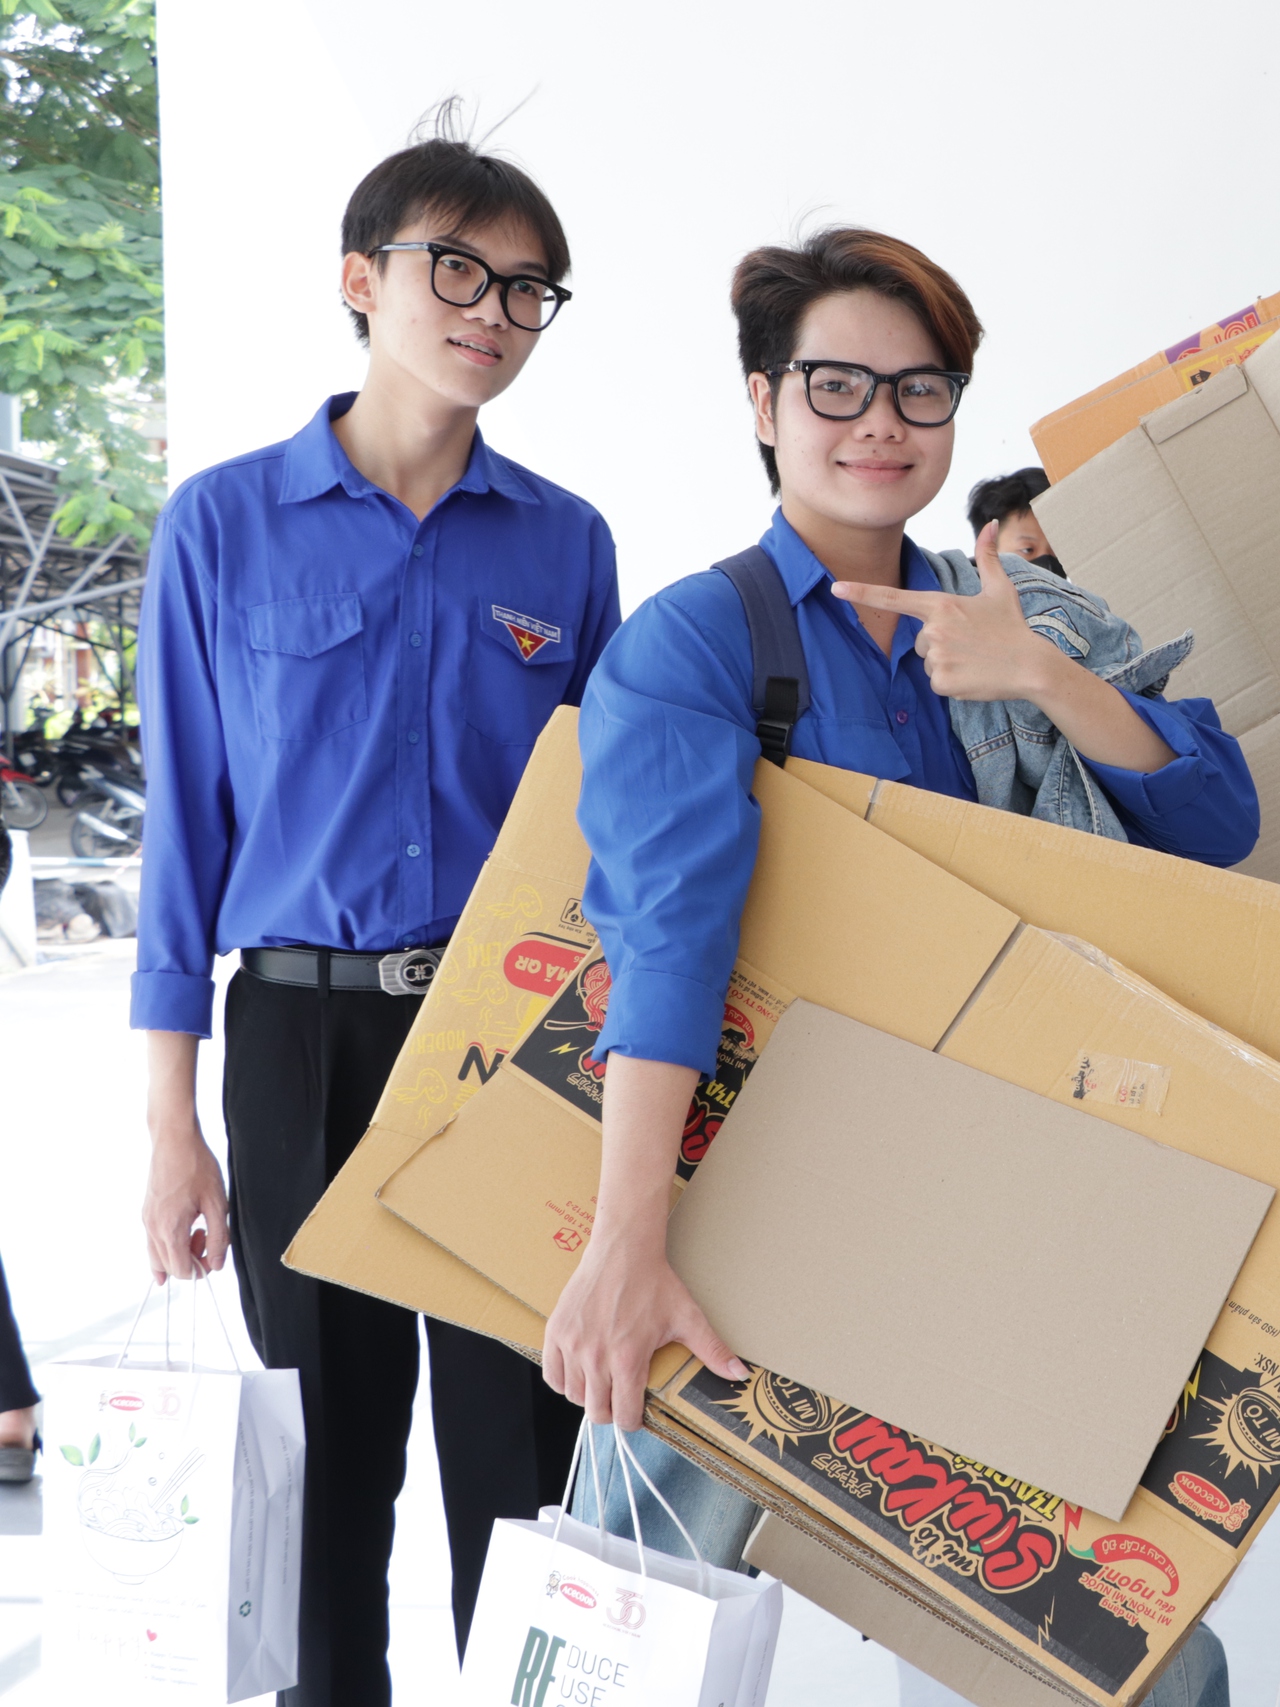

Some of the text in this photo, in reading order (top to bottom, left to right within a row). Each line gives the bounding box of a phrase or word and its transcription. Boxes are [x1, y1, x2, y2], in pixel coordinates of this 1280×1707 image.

[513, 952, 543, 976] QR
[728, 988, 756, 1008] TY CỔ
[725, 1007, 744, 1024] CAY
[733, 1058, 746, 1071] MÌ
[543, 1198, 566, 1217] (mm)
[562, 1212, 577, 1225] 180
[1225, 1299, 1280, 1338] (HSD sản phẩm
[1250, 1350, 1280, 1377] NSX:
[1242, 1404, 1268, 1428] TÔ
[807, 1446, 878, 1501] ゲキカラ
[1163, 1481, 1223, 1526] Cook happiness
[1101, 1539, 1176, 1577] mì CAY 7 CẤP ĐỘ
[1078, 1572, 1172, 1628] MÌ TRỘN, MÌ NƯỚC
[1095, 1559, 1176, 1616] đều ngon!
[1099, 1596, 1139, 1626] Ăn dạng
[566, 1644, 630, 1689] DUCE
[559, 1679, 607, 1707] USE
